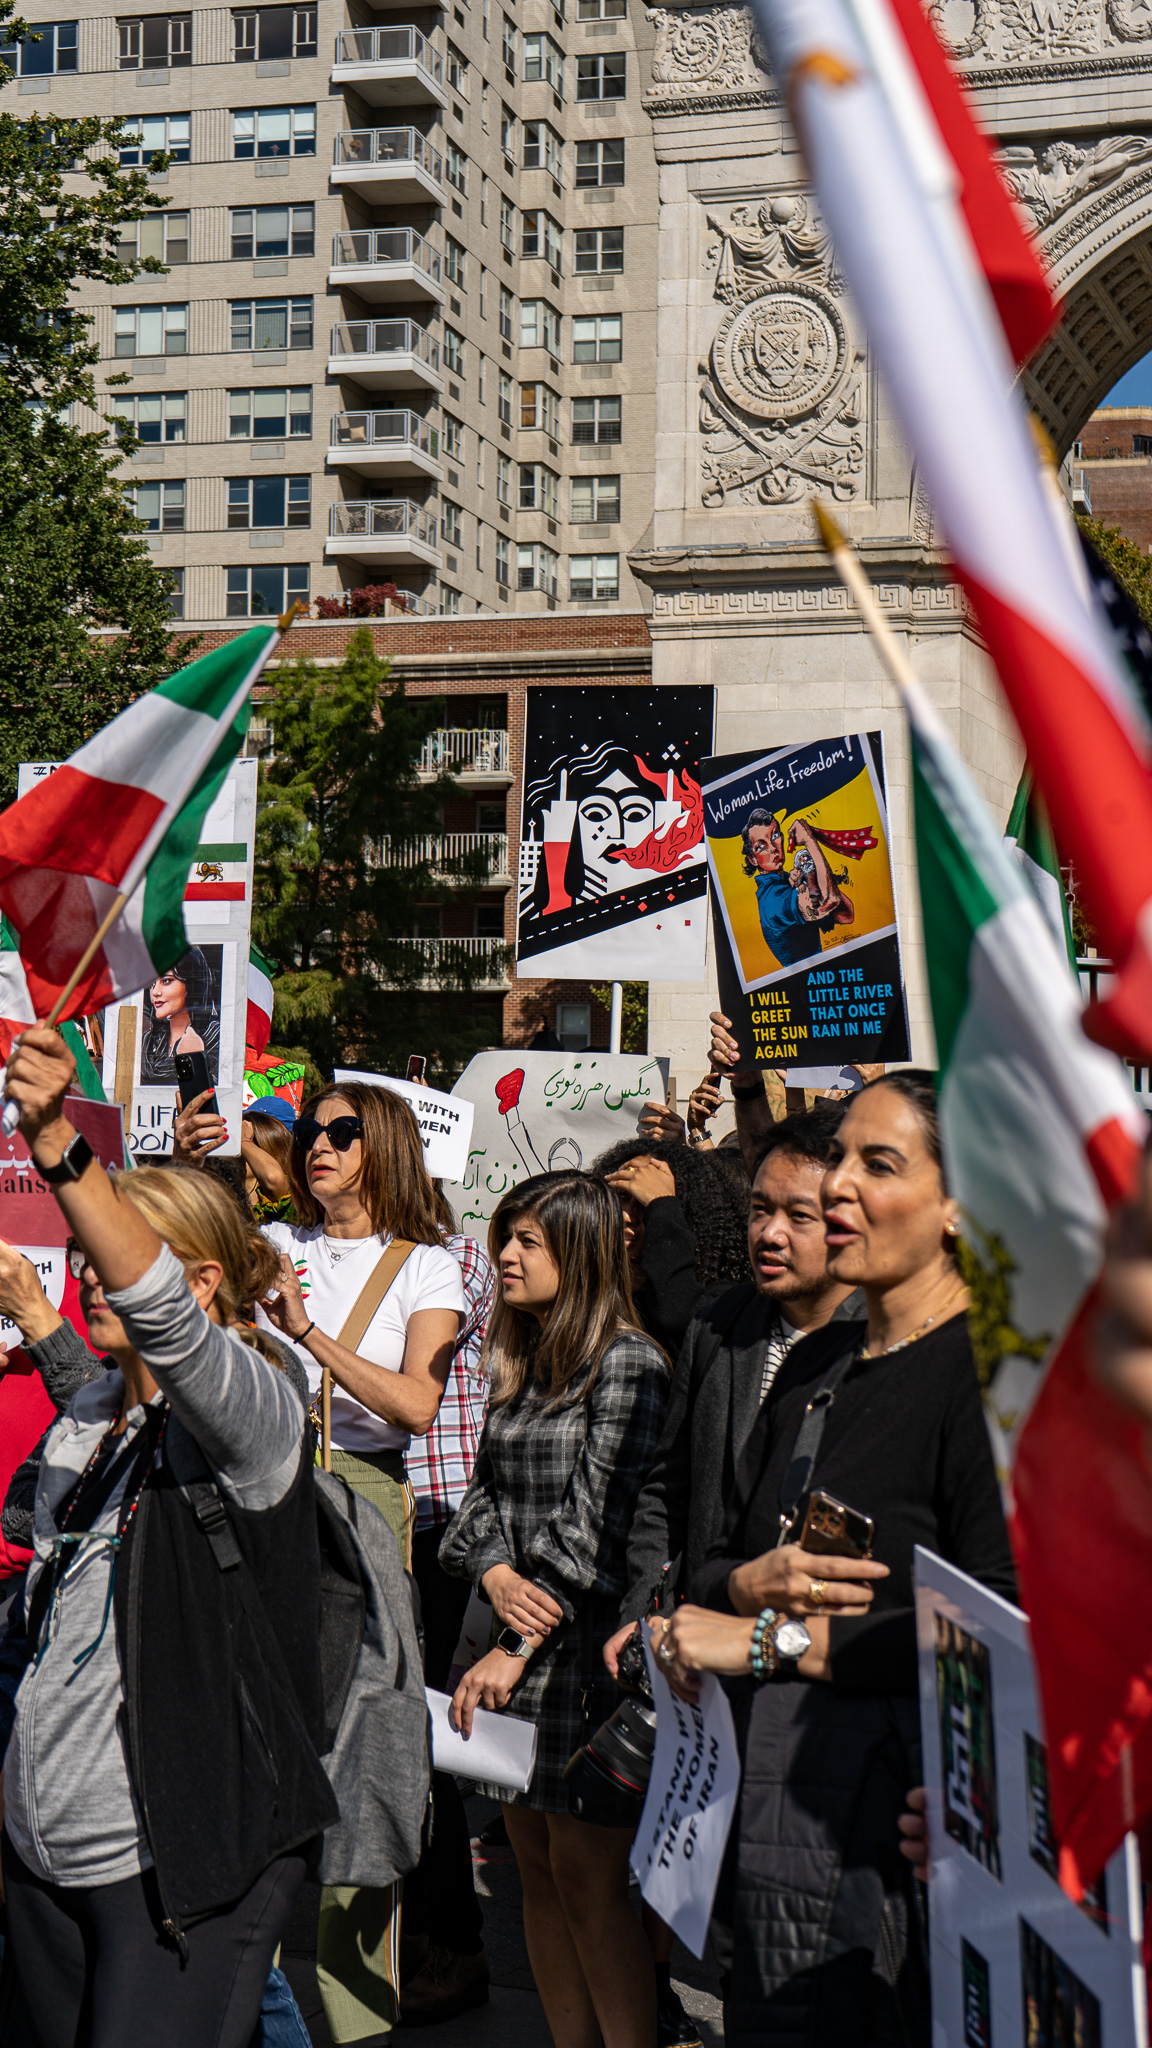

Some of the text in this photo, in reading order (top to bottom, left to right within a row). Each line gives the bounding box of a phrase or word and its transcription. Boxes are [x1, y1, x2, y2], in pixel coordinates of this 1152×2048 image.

[707, 735, 854, 823] Woman, Life, Freedom!
[807, 968, 864, 986] AND THE
[749, 991, 790, 1007] I WILL
[808, 983, 894, 1003] LITTLE RIVER
[751, 1008, 792, 1024] GREET
[809, 1002, 886, 1021] THAT ONCE
[752, 1025, 808, 1042] THE SUN
[811, 1020, 882, 1038] RAN IN ME
[754, 1043, 798, 1060] AGAIN
[418, 1099, 460, 1123] WITH
[417, 1119, 452, 1136] MEN
[652, 1745, 686, 1848] STAND
[670, 1690, 690, 1739] WIT
[683, 1735, 719, 1861] OF IRAN
[657, 1808, 683, 1870] THE
